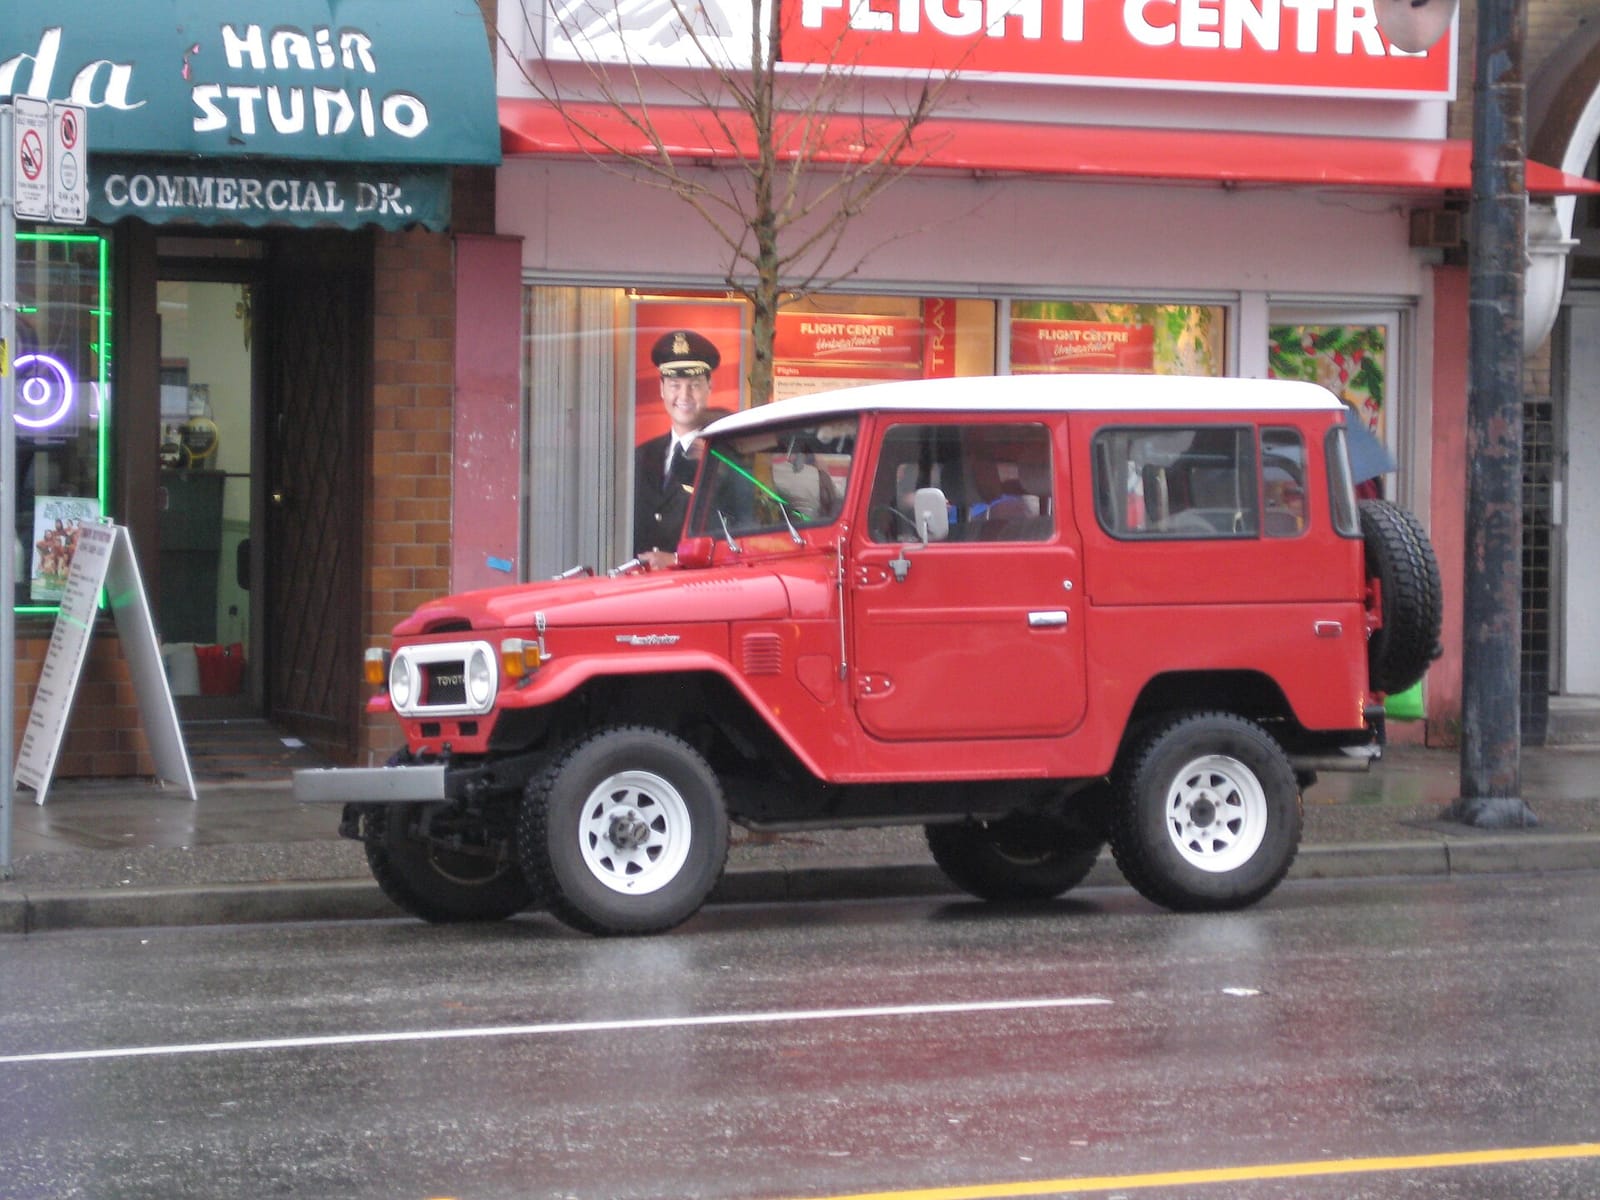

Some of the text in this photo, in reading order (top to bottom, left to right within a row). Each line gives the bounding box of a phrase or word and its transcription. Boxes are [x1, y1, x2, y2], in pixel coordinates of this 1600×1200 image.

[1123, 0, 1429, 58] CENTR
[192, 83, 429, 138] STUDIO
[104, 174, 344, 213] COMMERCIAL
[355, 182, 413, 215] DR.
[800, 322, 894, 337] FLIGHT CENTRE
[1038, 328, 1129, 343] FLIGHT CENTRE
